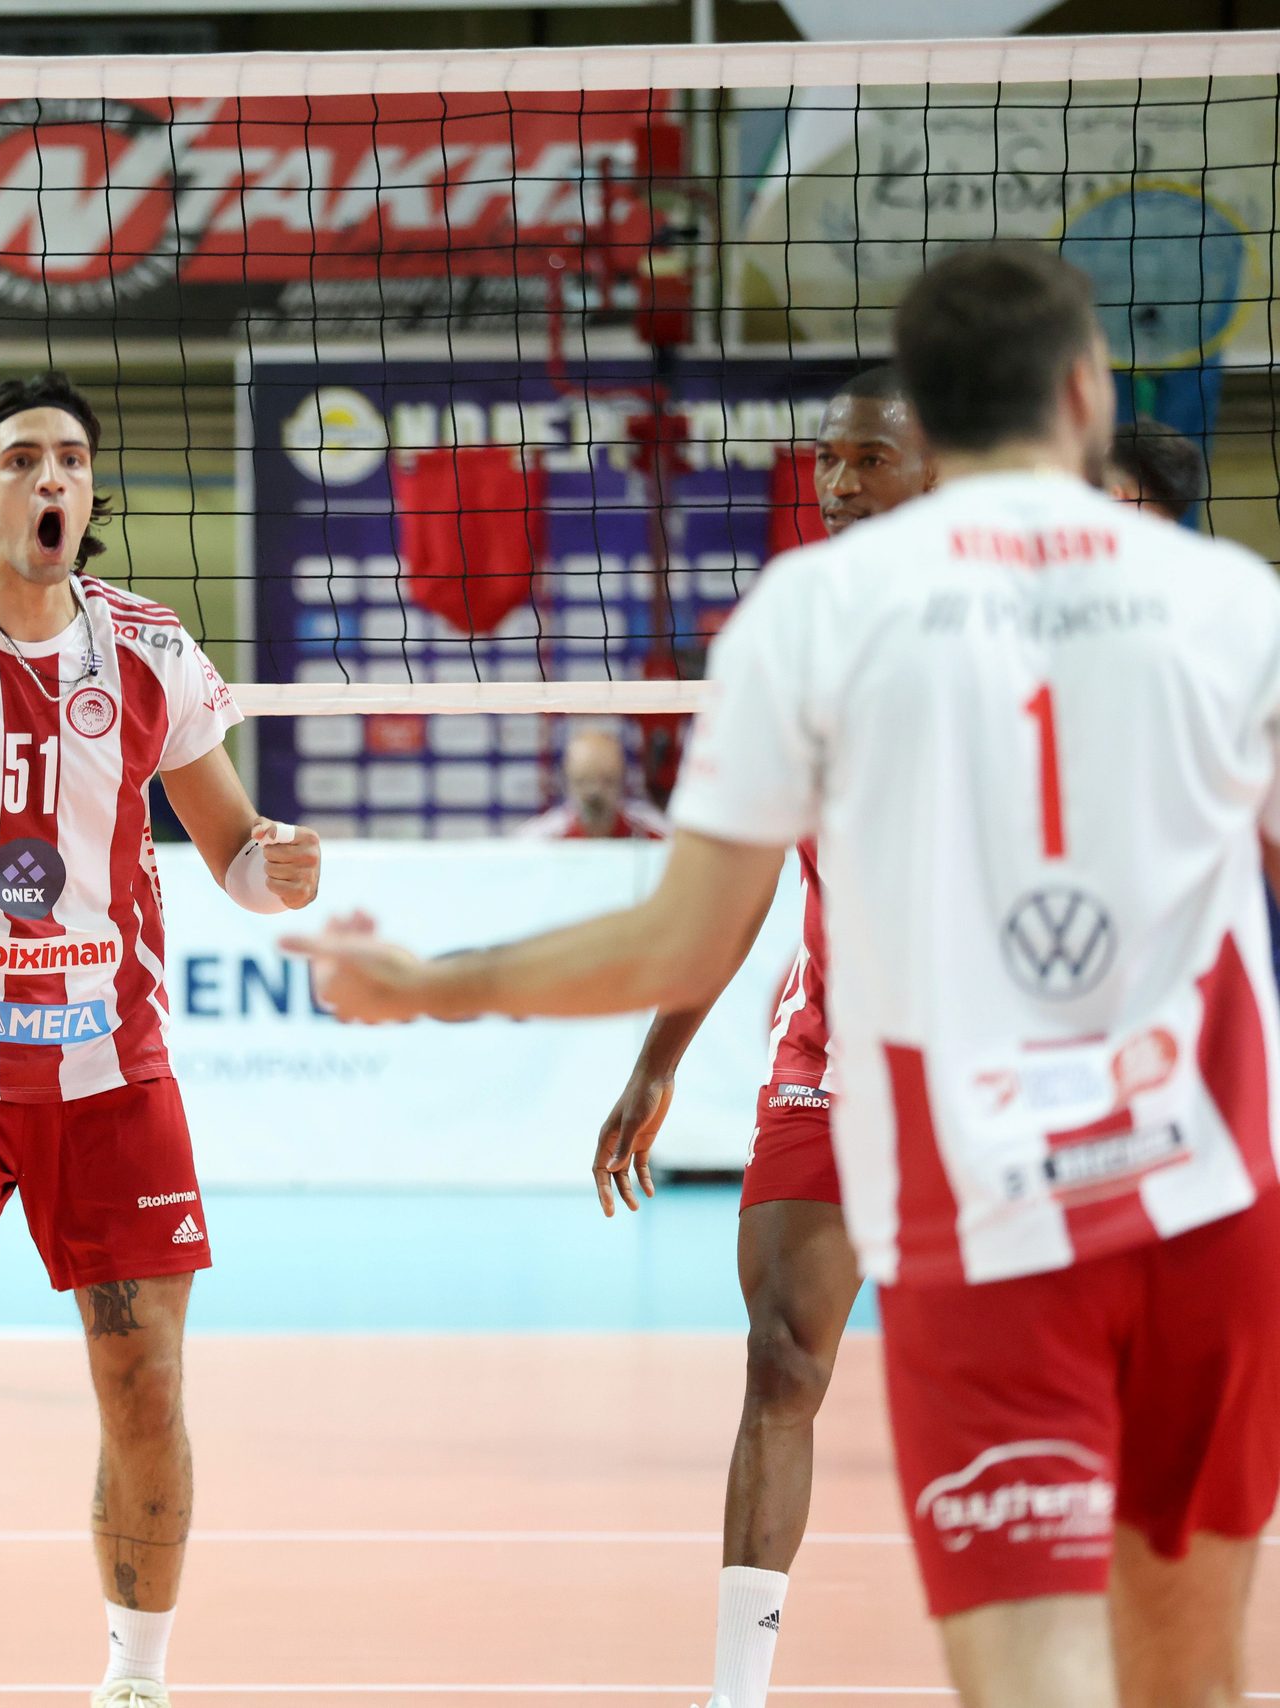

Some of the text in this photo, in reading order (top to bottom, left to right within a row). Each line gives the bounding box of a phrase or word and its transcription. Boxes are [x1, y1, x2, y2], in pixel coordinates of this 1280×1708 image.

[3, 733, 60, 815] 51
[1023, 681, 1066, 859] 1
[1, 888, 45, 903] ONEX
[8, 1005, 103, 1040] ΜΕΓΑ
[785, 1085, 815, 1097] ONEX
[768, 1096, 830, 1109] SHIPYARDS
[137, 1190, 197, 1209] Stoiximan
[172, 1231, 205, 1244] adidas
